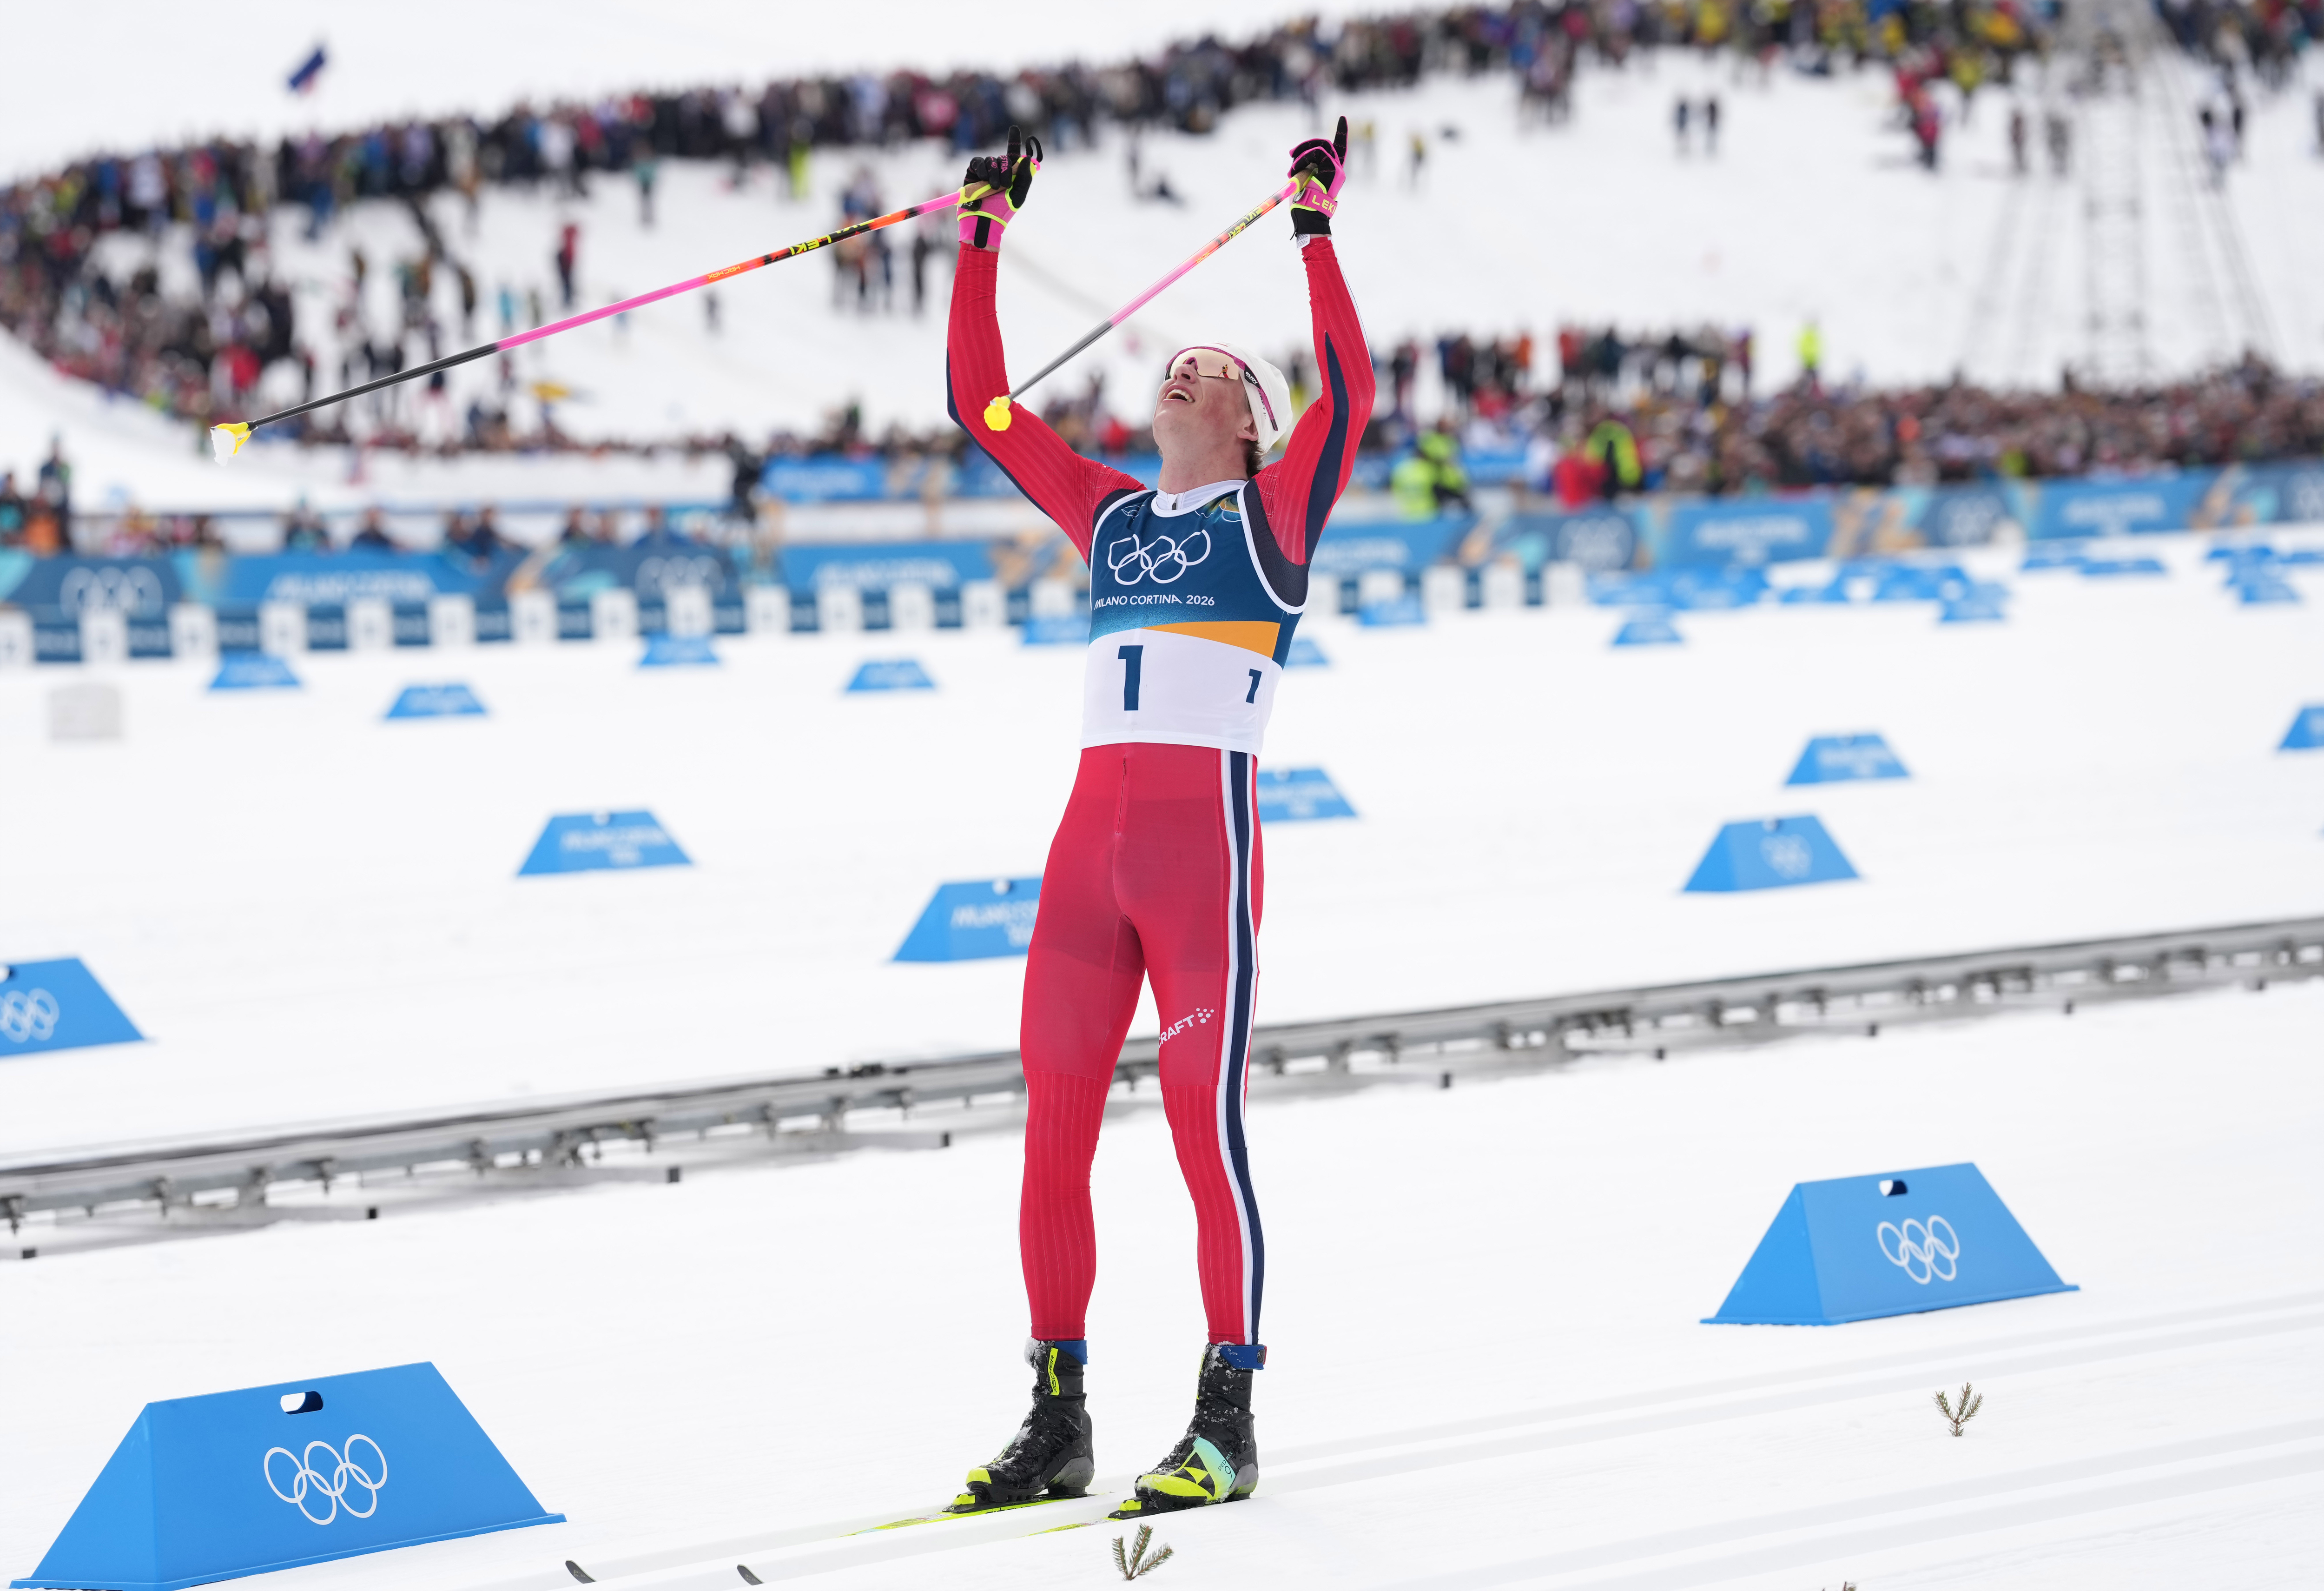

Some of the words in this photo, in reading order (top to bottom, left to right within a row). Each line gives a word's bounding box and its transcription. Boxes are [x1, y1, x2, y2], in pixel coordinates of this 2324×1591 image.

[1312, 194, 1336, 214] LEKI
[789, 234, 832, 256] LEKI
[707, 270, 724, 279] MAX
[723, 265, 741, 274] HRC
[1245, 371, 1258, 384] RUDY
[1094, 595, 1128, 610] MILANO
[1129, 594, 1183, 605] CORTINA
[1186, 594, 1215, 606] 2026
[1117, 645, 1144, 711] 1
[1246, 668, 1262, 704] 1
[1049, 1354, 1058, 1393] FISCHER
[1218, 1459, 1227, 1472] SPEED
[1224, 1465, 1233, 1479] 9
